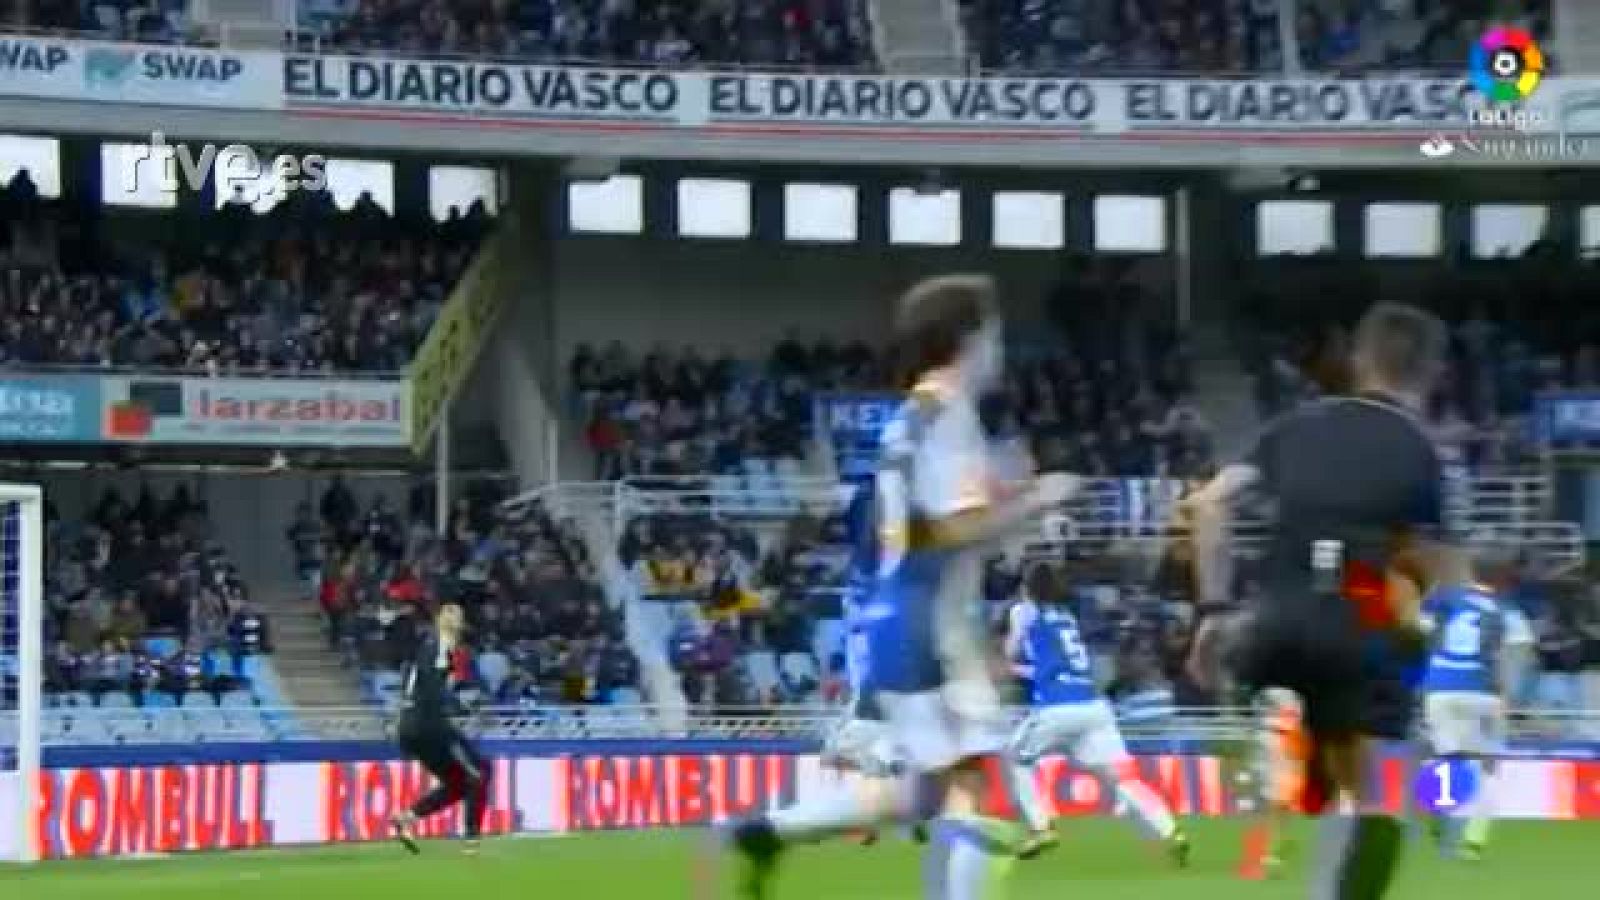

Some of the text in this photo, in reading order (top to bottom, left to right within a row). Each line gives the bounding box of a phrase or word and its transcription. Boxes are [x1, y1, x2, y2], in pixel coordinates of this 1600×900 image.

[142, 52, 243, 81] SWAP
[283, 58, 680, 112] EL DIARIO VASCO
[709, 77, 1095, 121] EL DIARIO VASCO
[1126, 83, 1180, 120] EL
[1187, 83, 1346, 121] DIARIO
[193, 387, 400, 421] larzabal
